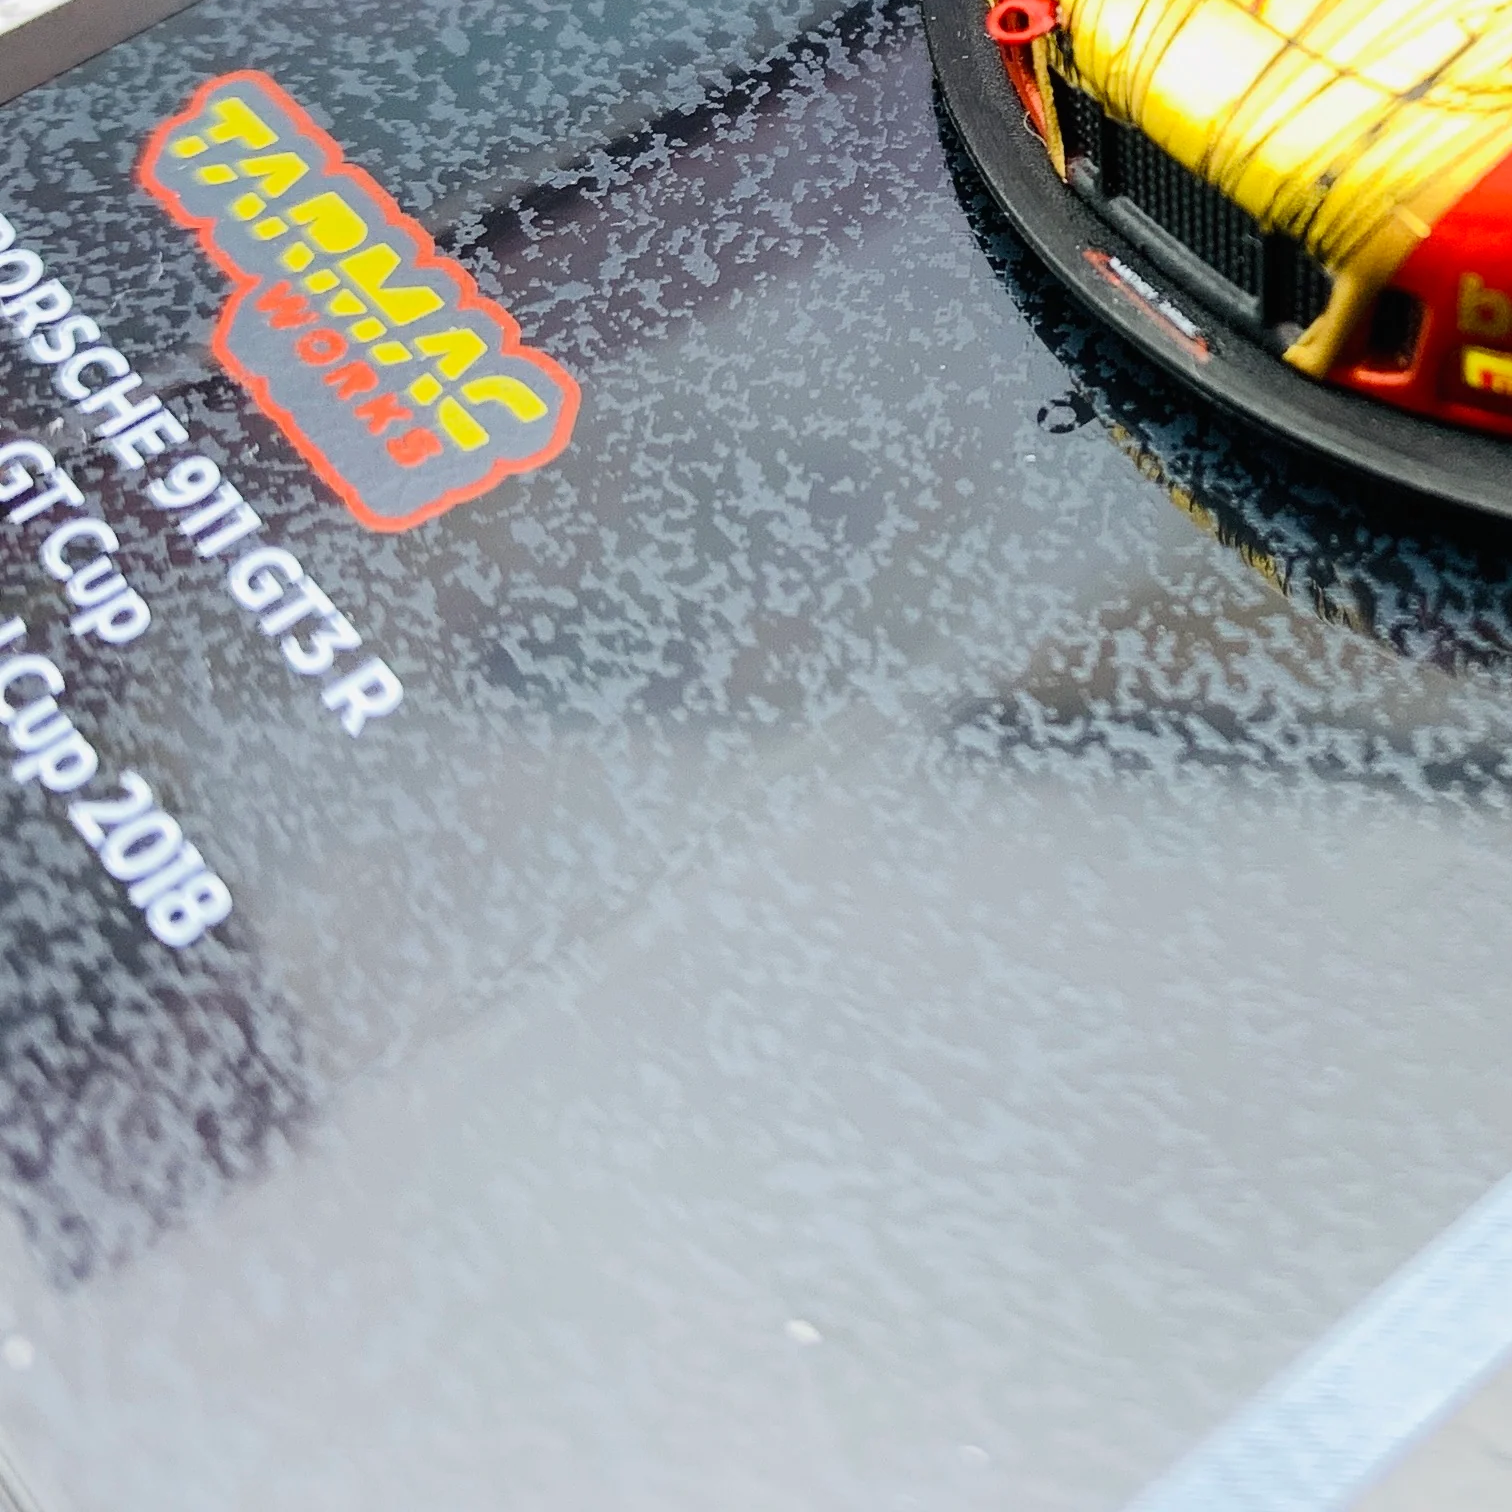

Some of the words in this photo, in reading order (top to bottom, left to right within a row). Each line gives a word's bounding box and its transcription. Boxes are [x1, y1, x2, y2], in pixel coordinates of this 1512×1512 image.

[168, 97, 548, 451] TARMAC
[255, 282, 443, 467] WORKS
[0, 439, 85, 525] GT
[40, 516, 151, 644] Cup
[148, 454, 264, 558] 911
[228, 543, 363, 675] GT3
[321, 654, 403, 738] R
[0, 653, 99, 791] Cup
[66, 769, 232, 950] 2018
